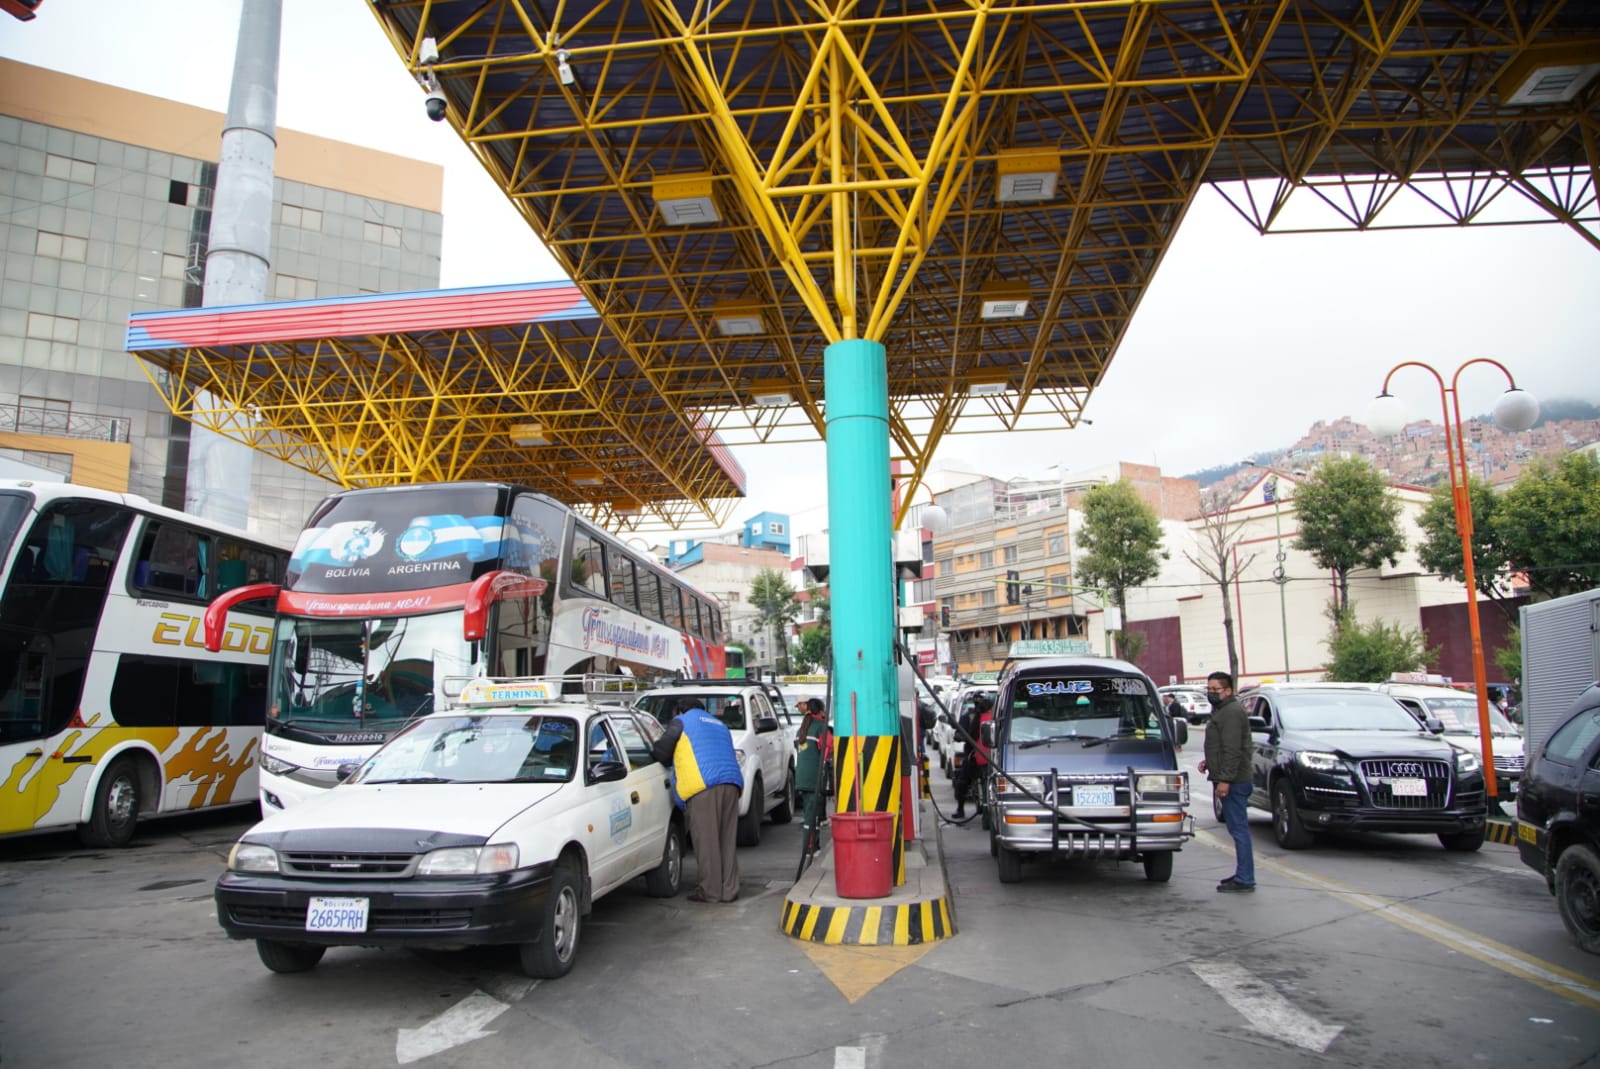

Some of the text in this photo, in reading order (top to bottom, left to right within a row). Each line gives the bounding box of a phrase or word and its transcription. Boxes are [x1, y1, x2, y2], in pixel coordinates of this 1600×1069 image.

[324, 568, 371, 578] BOLIVIA
[387, 560, 461, 575] ARGENTINA
[491, 689, 545, 700] TERMINAL
[1027, 680, 1094, 696] BLUE
[335, 733, 383, 741] Marcopolo
[310, 909, 365, 928] 2685PRH
